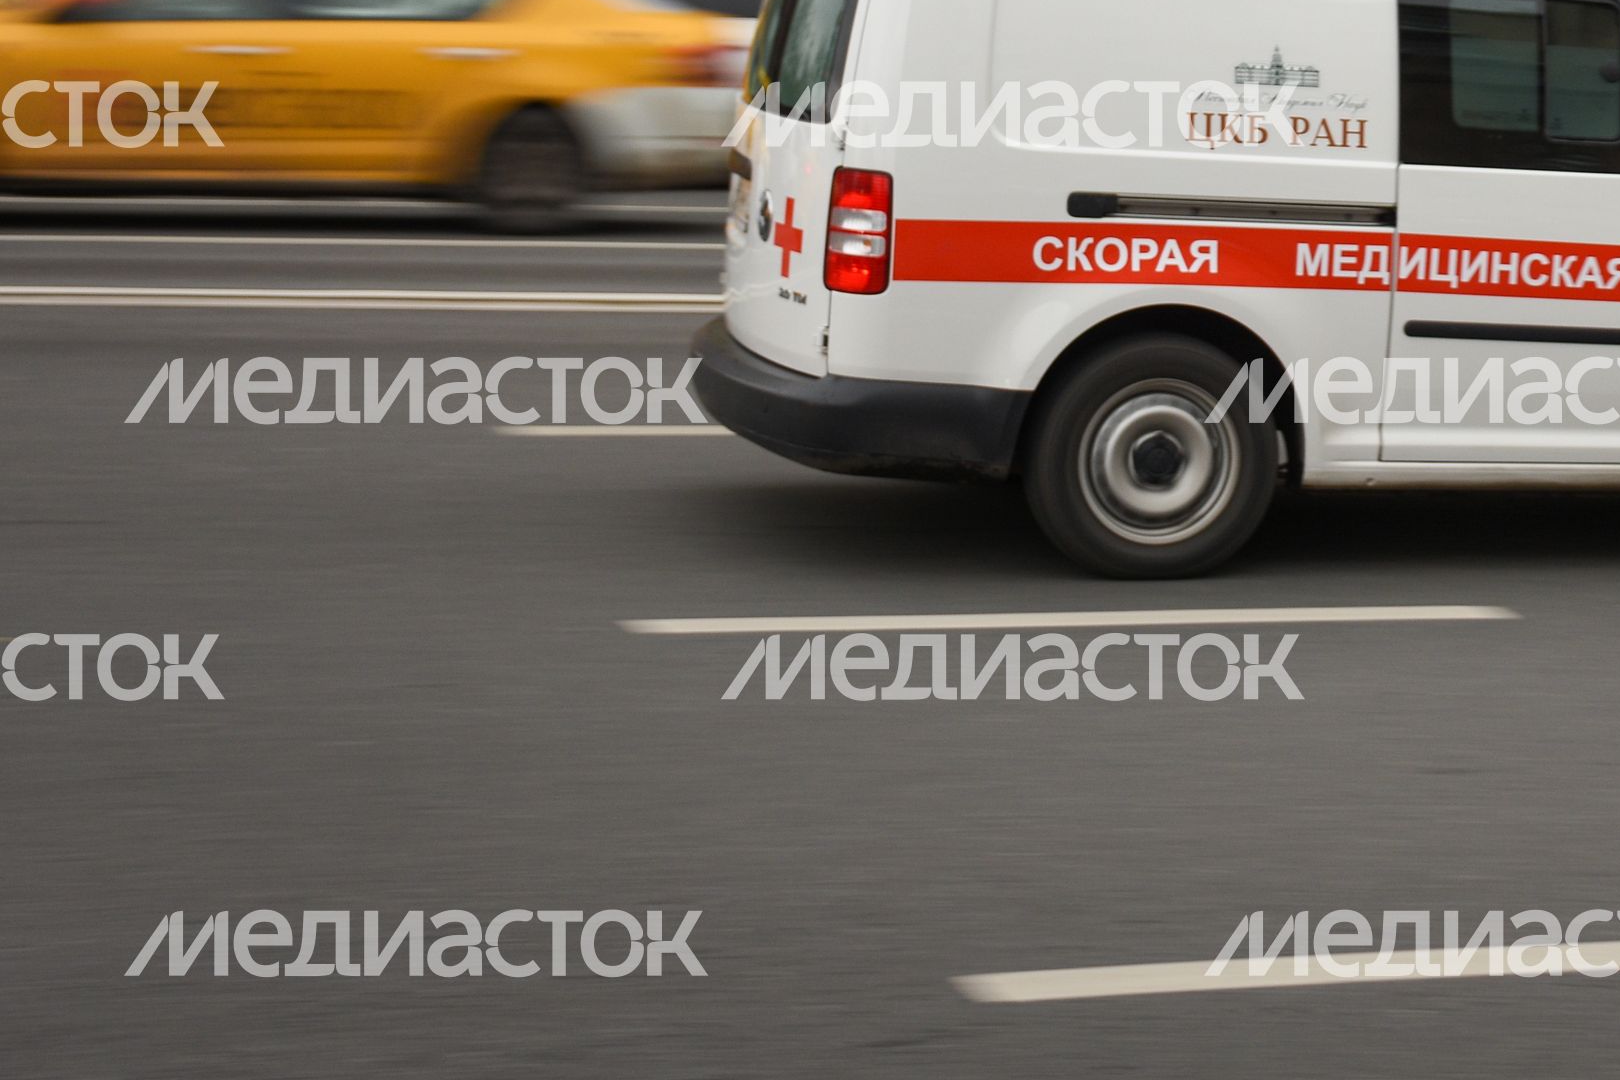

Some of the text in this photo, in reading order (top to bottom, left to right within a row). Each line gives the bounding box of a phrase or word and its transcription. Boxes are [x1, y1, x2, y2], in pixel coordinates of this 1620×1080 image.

[1185, 111, 1369, 150] ЦКБ РАН
[1032, 235, 1220, 274] СКОРАЯ
